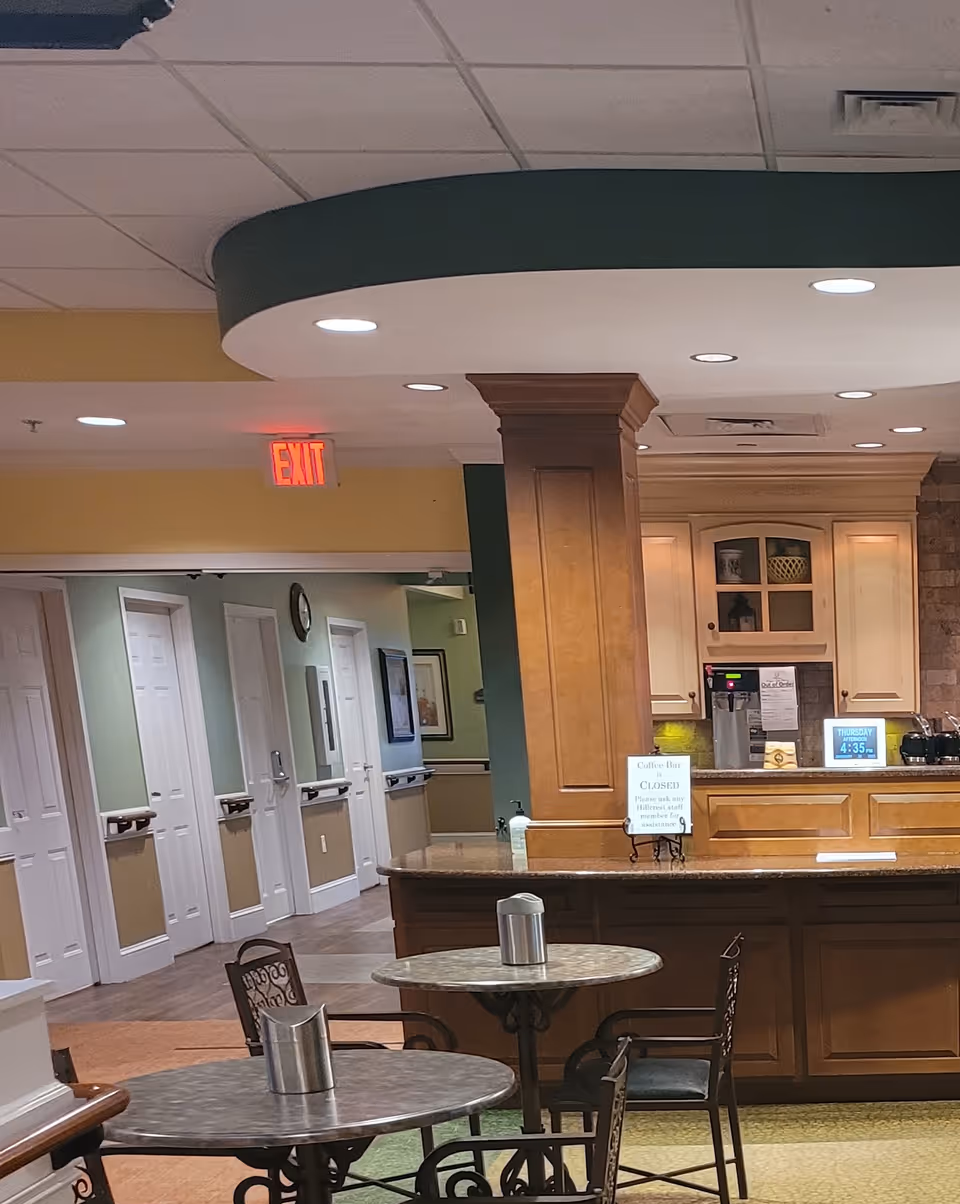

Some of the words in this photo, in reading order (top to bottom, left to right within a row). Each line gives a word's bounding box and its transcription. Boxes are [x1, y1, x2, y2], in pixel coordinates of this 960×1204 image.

[272, 441, 325, 486] EXIT
[837, 728, 873, 737] THURSDAY
[840, 742, 865, 754] 4:35
[637, 761, 663, 769] Coffee
[666, 760, 681, 769] Bar
[640, 780, 680, 790] CLOSED
[668, 803, 683, 811] staff
[669, 811, 679, 819] for
